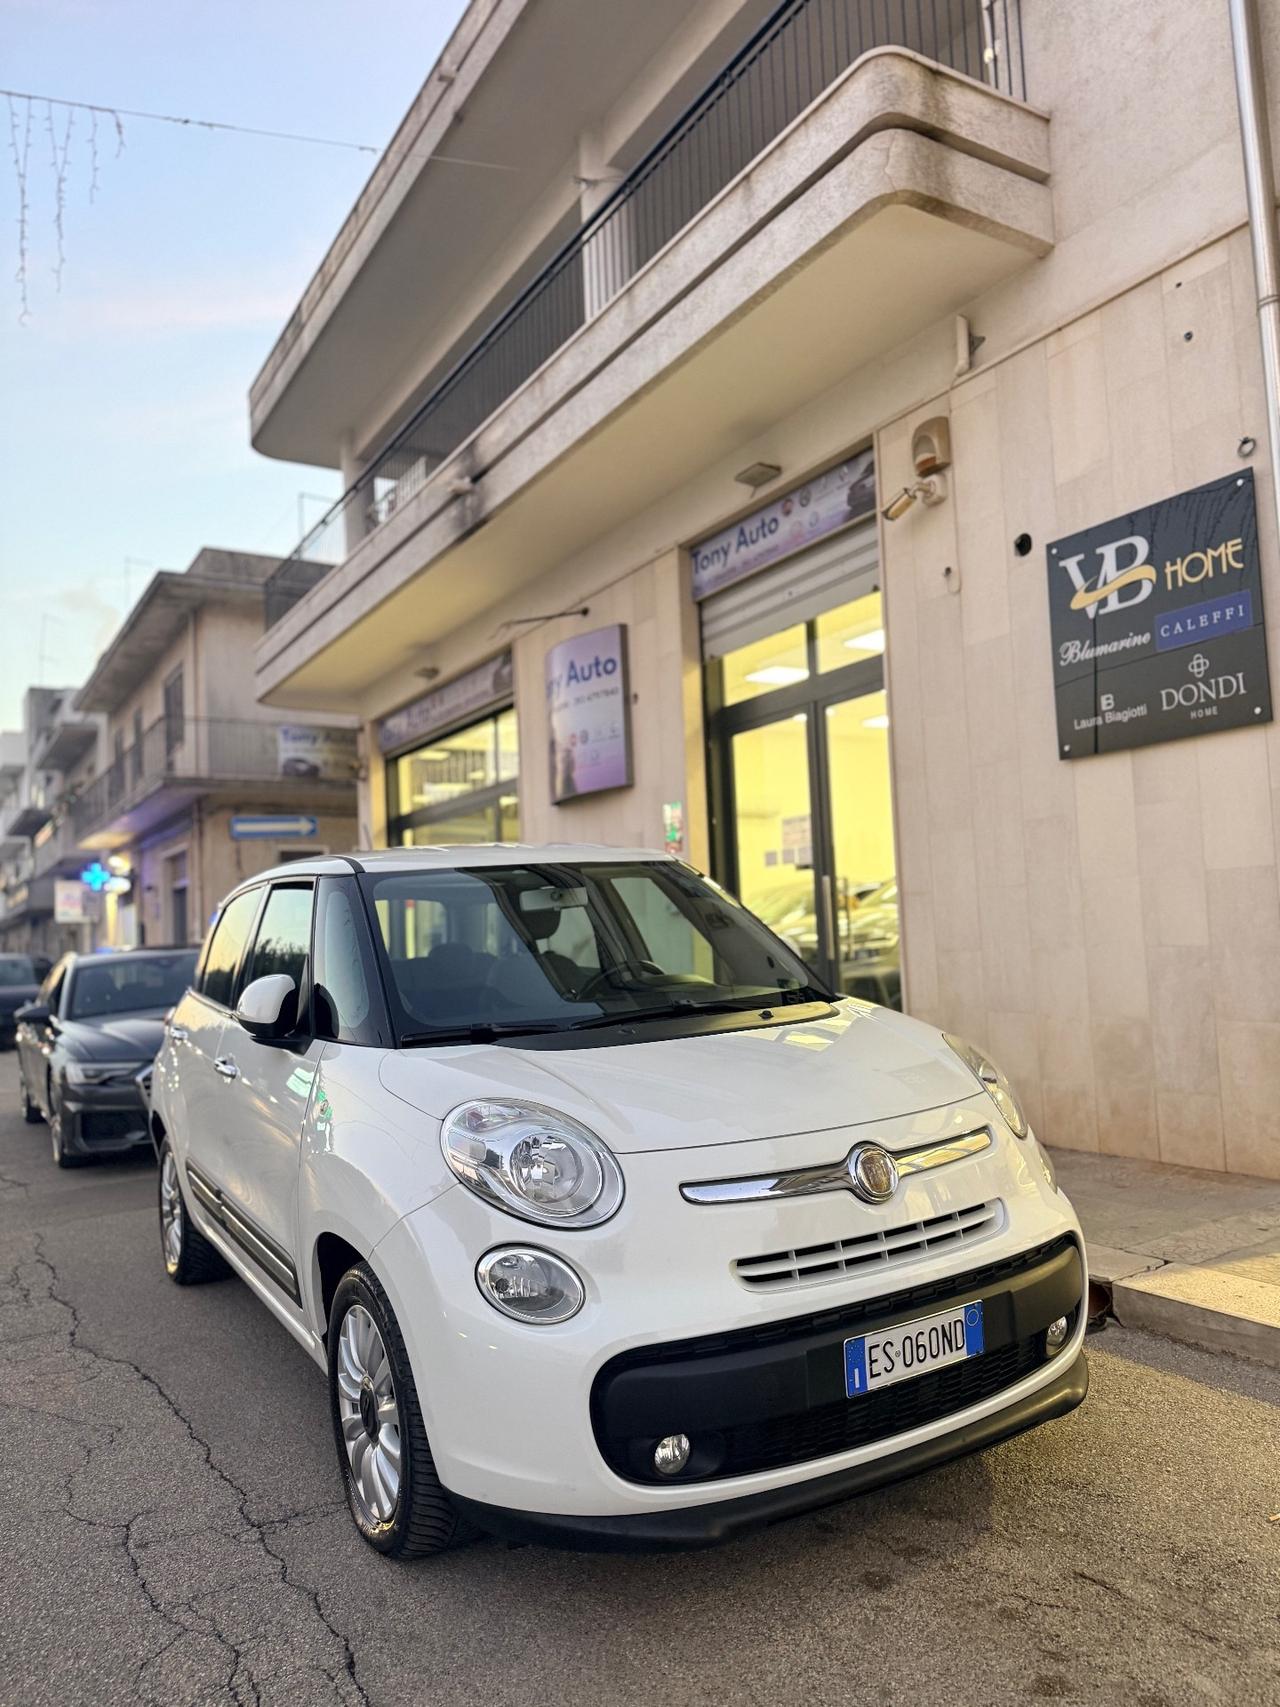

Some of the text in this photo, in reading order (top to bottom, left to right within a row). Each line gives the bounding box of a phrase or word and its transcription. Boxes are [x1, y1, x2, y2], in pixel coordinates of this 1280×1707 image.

[691, 542, 732, 574] Tony
[735, 516, 780, 554] Auto
[1164, 537, 1245, 591] HOME
[1160, 604, 1245, 638] CALEFFI
[1059, 631, 1152, 667] Blumarine
[566, 655, 617, 687] Auto
[1161, 672, 1248, 712] DONDI
[1074, 703, 1148, 731] Laura Biagiotti
[1190, 706, 1219, 720] HOME
